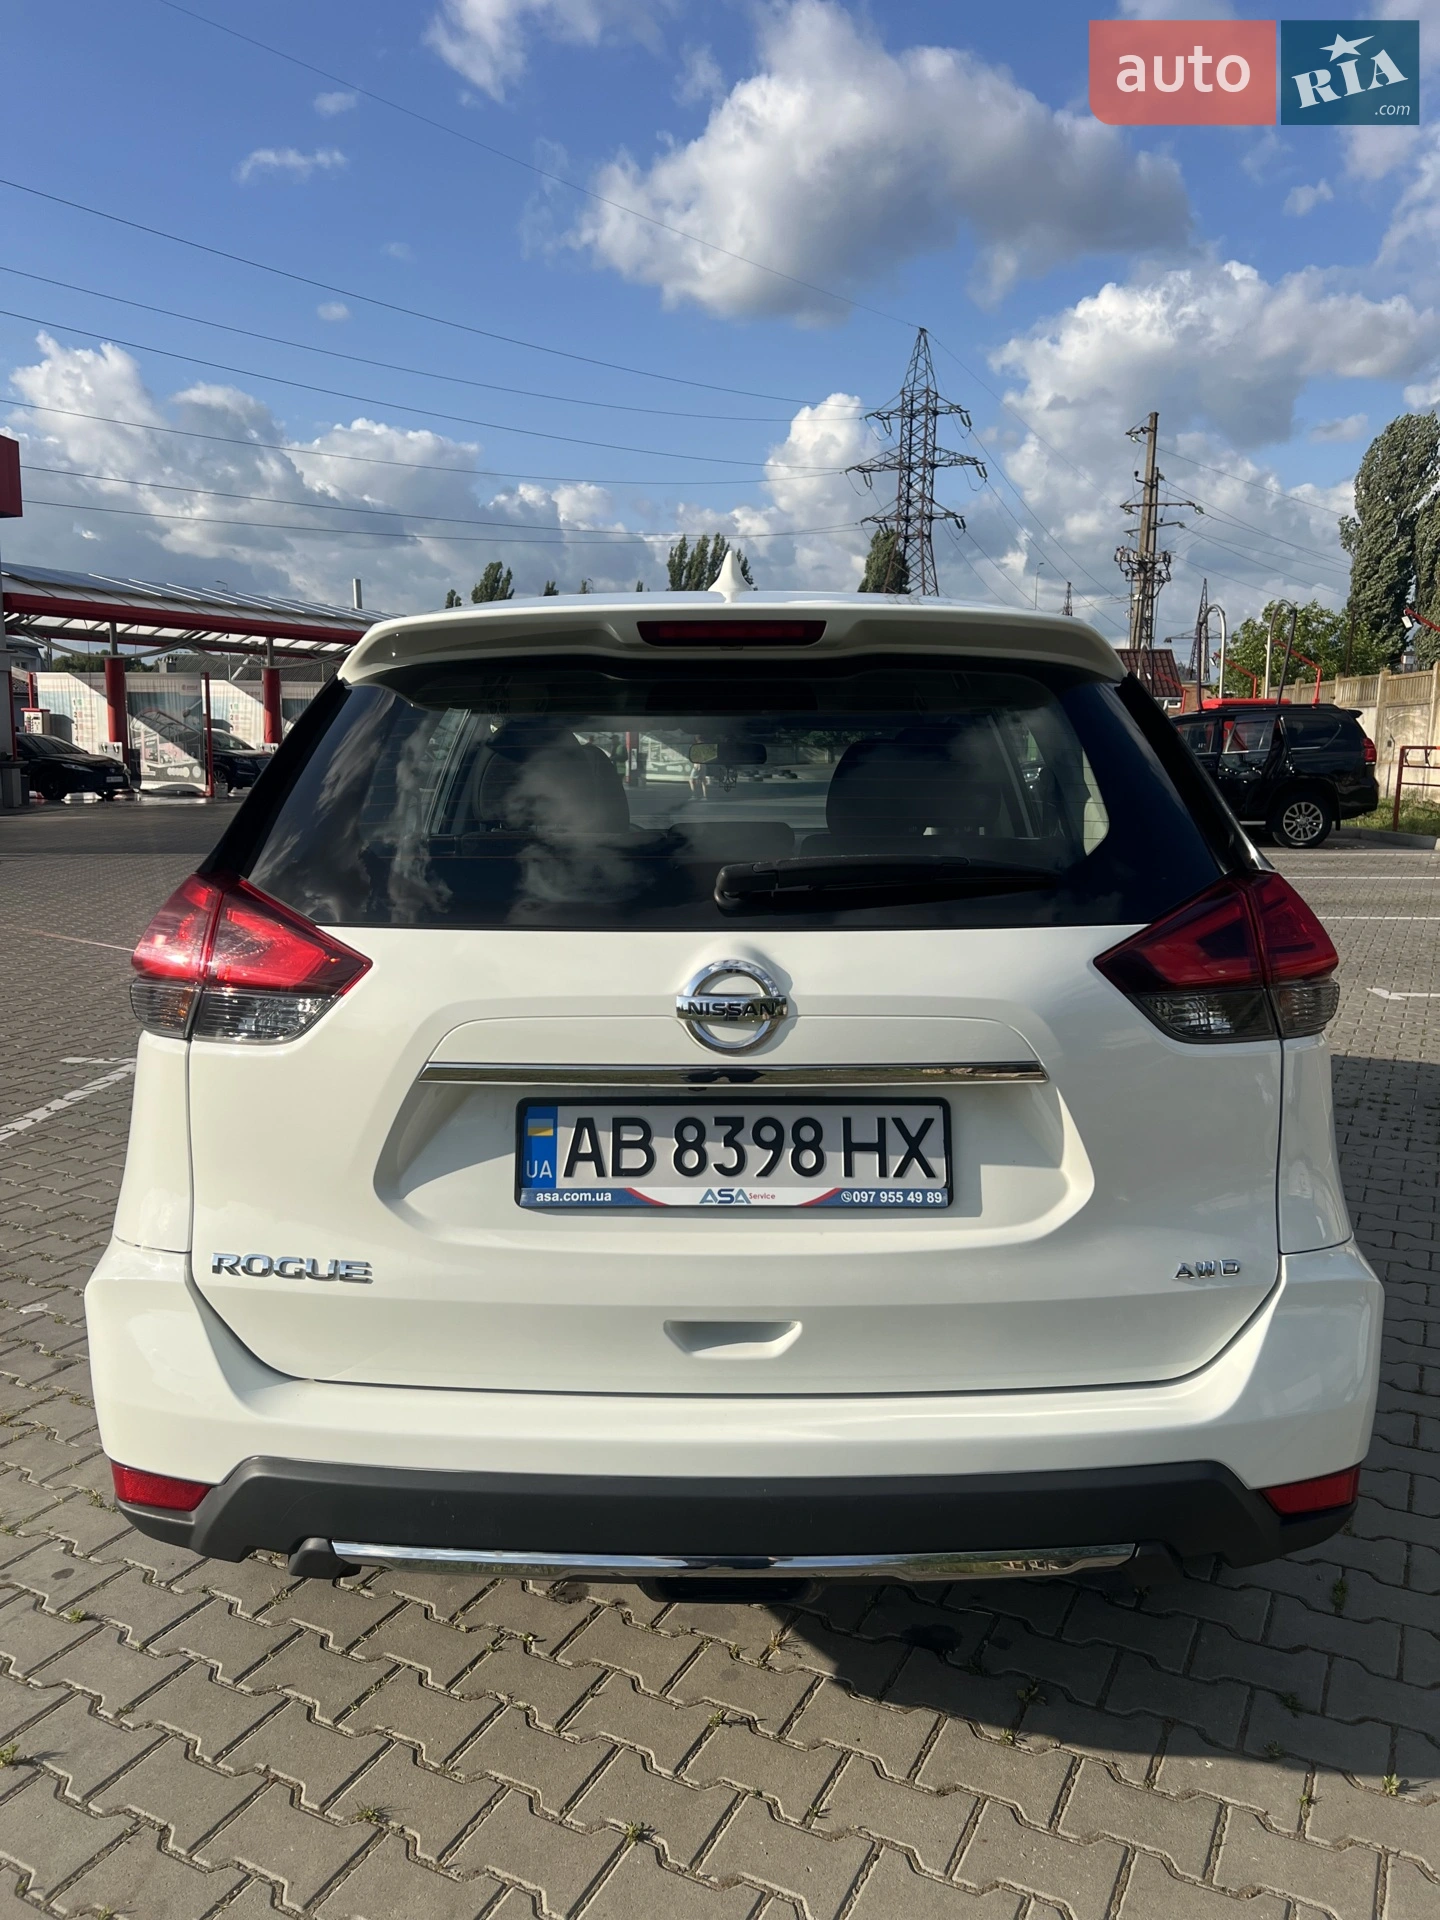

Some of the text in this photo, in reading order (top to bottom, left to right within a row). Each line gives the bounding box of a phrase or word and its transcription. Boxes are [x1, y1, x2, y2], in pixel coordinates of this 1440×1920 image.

[687, 1001, 777, 1017] NISSAN
[563, 1117, 936, 1178] AB 8398 HX
[526, 1160, 553, 1178] UA
[536, 1191, 612, 1202] asa.com.ua
[699, 1188, 776, 1204] ASA Service
[852, 1190, 942, 1203] 097 955 49 89
[212, 1252, 374, 1284] ROGUE
[1172, 1259, 1240, 1279] AWD
